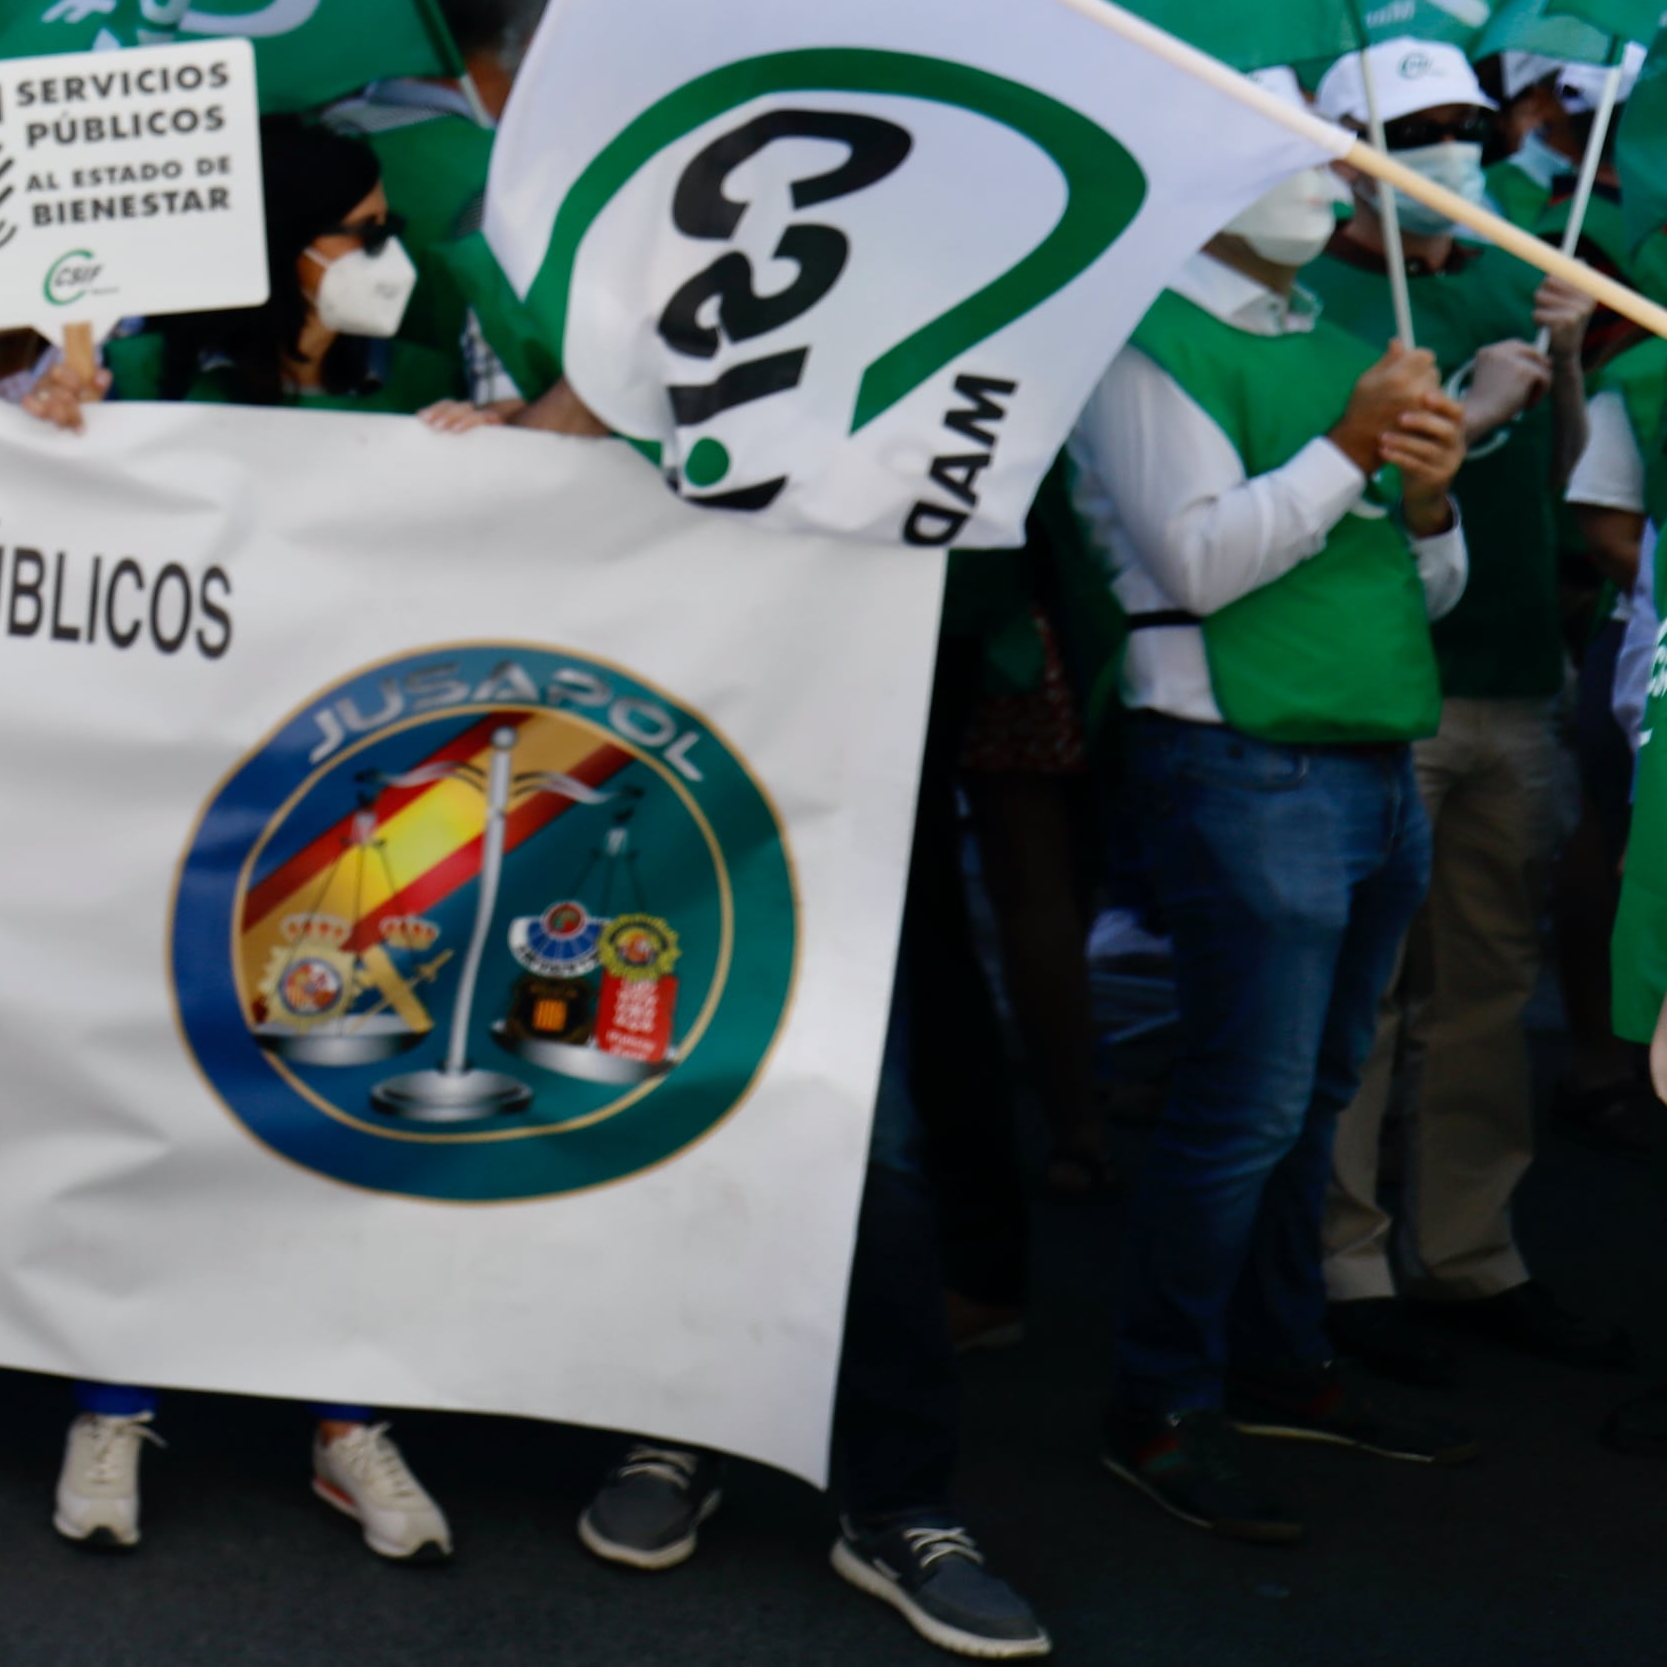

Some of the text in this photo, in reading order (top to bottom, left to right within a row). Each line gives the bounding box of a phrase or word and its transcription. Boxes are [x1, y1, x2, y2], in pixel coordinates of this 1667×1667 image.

[16, 60, 231, 108] SERVICIOS
[26, 105, 227, 150] PÚBLICOS
[25, 155, 232, 194] AL ESTADO DE
[33, 187, 232, 229] BIENESTAR
[310, 659, 704, 782] JUSAPOL
